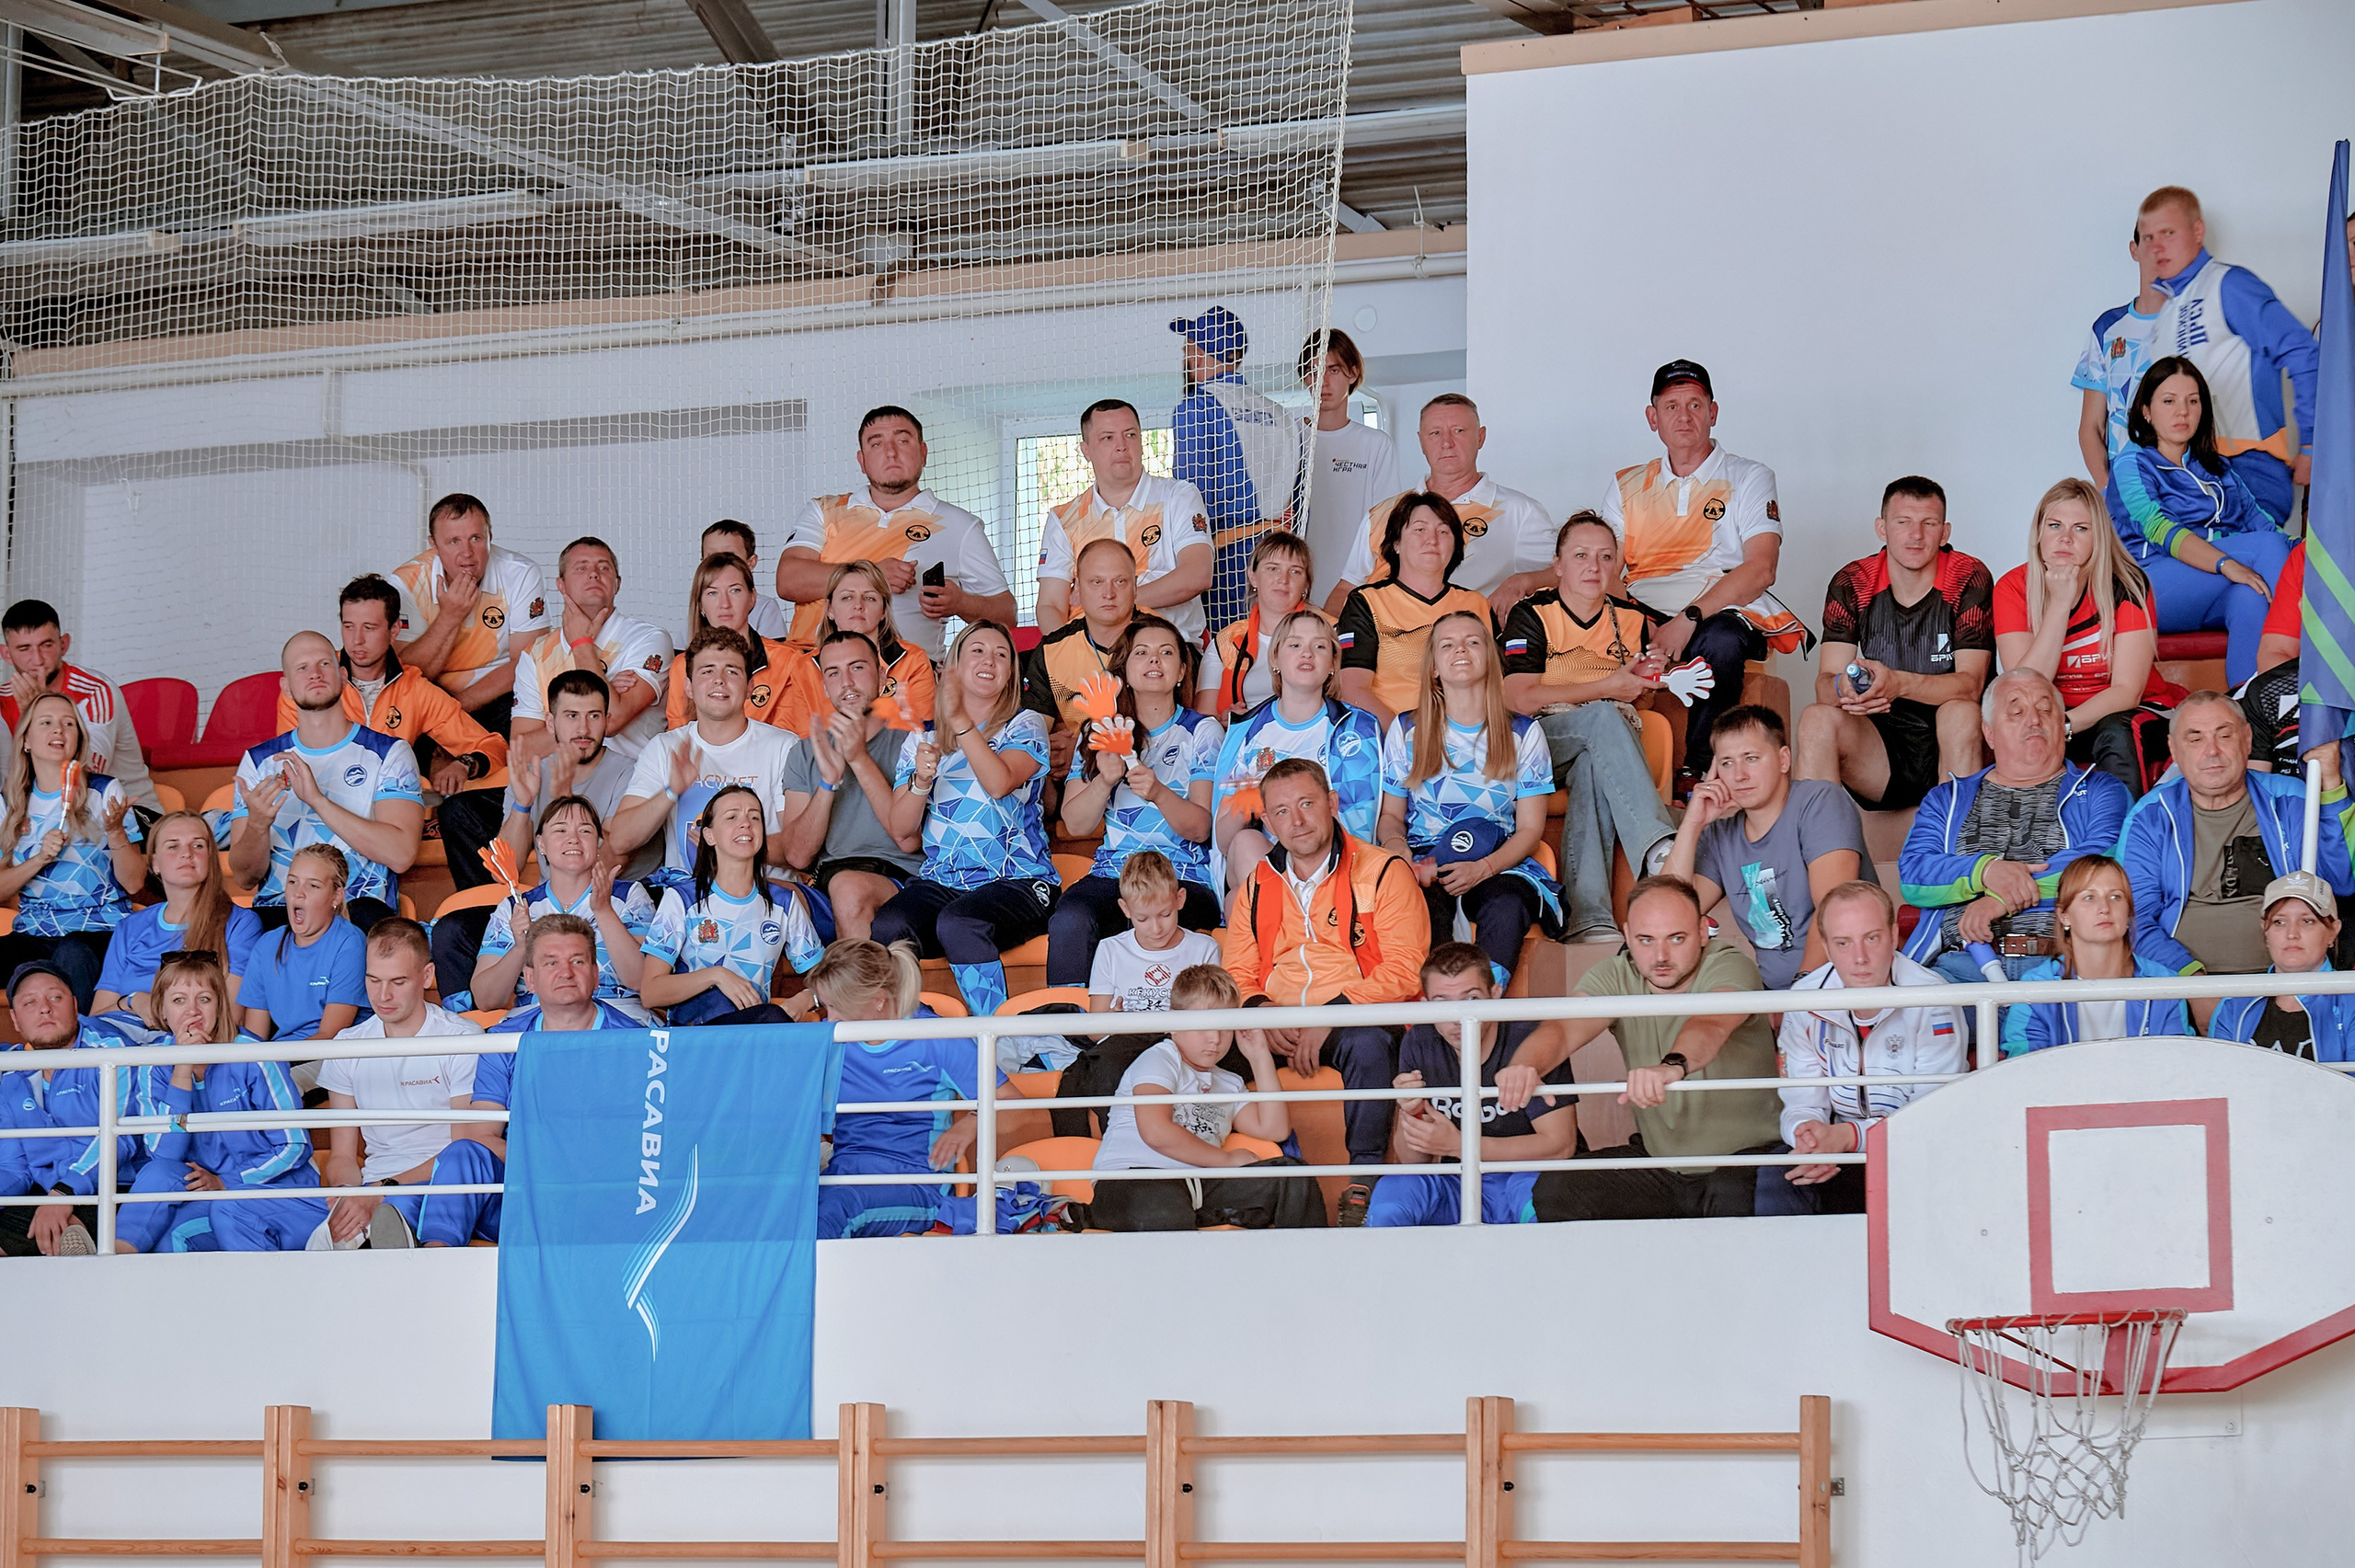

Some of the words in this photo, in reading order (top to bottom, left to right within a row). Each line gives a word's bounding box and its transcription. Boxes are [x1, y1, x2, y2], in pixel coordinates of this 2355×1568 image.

[1335, 461, 1367, 469] ЧЕСТНАЯ
[692, 774, 758, 791] ACQUET
[1128, 986, 1172, 1000] КЁКУС
[636, 1029, 671, 1216] РАСАВИА
